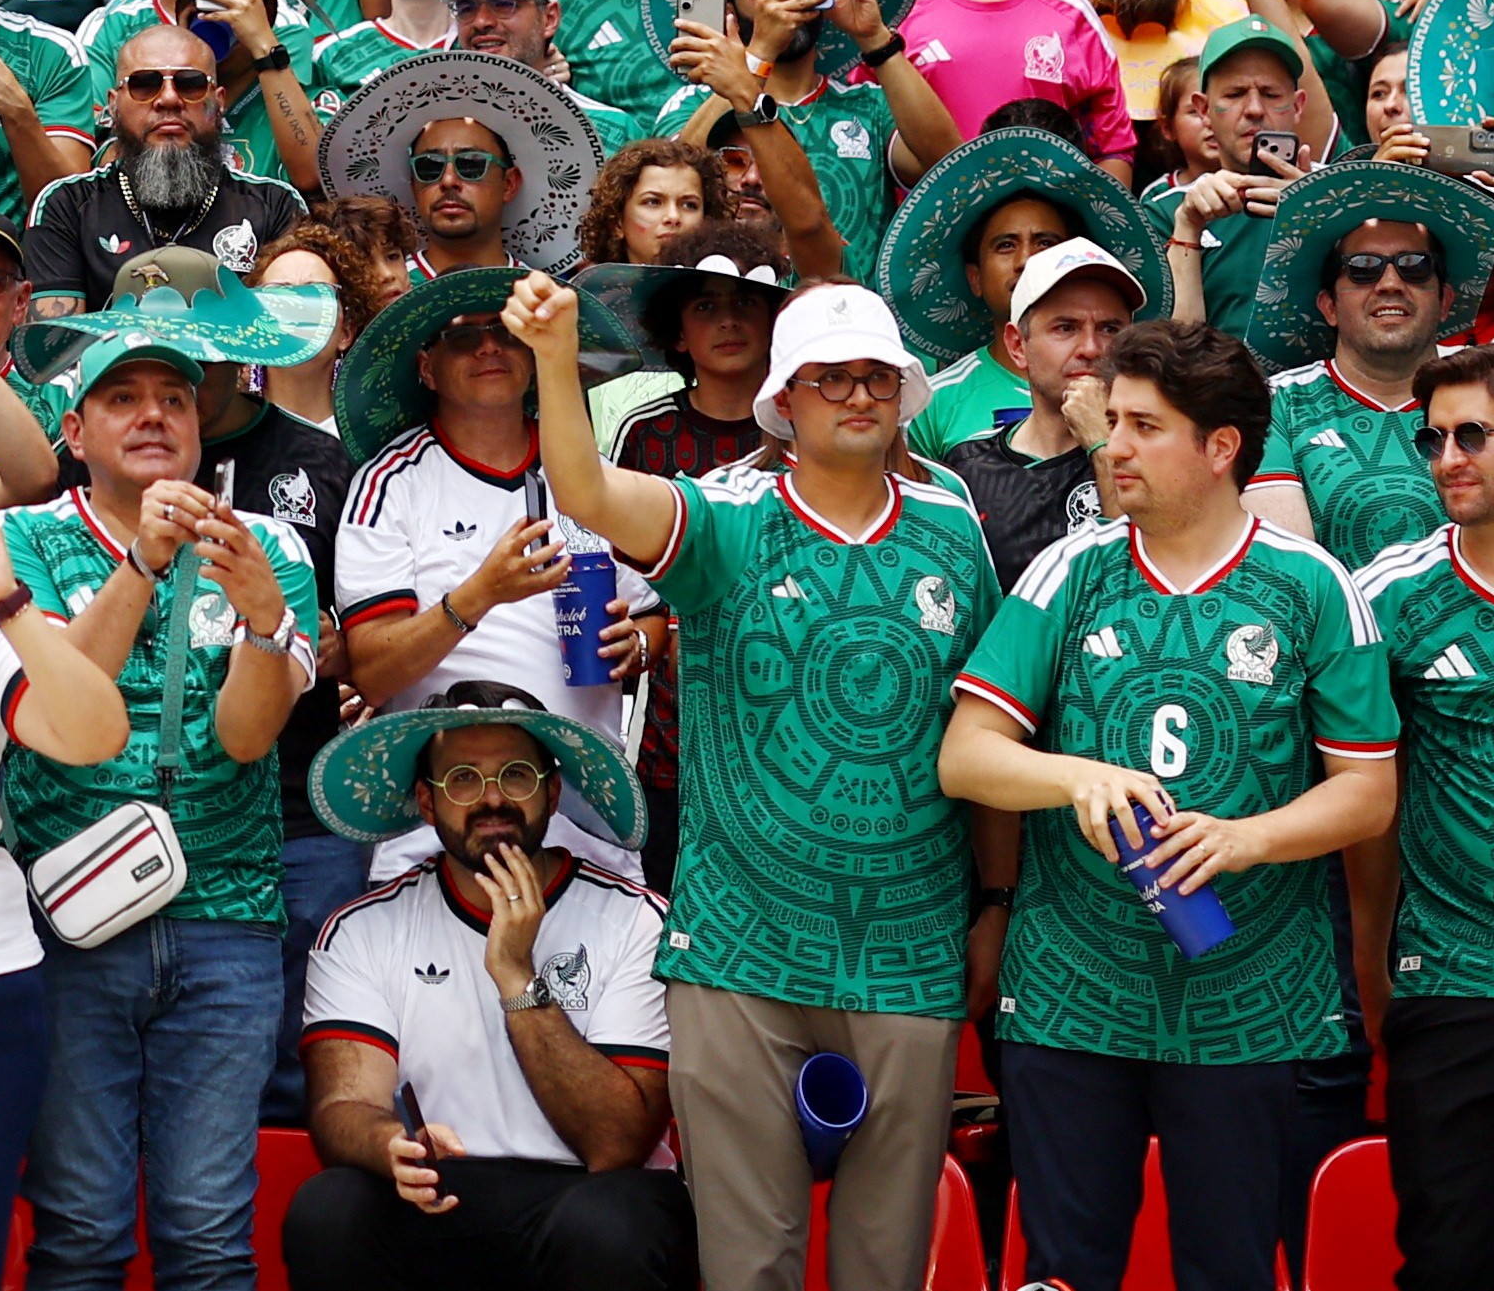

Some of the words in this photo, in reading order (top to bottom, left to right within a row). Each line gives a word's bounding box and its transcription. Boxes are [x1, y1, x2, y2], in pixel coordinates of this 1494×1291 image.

[445, 53, 472, 61] FIFA
[1409, 38, 1424, 67] FIFA
[374, 68, 398, 87] FIFA
[520, 68, 544, 87] FIFA
[574, 114, 592, 137] FIFA
[992, 131, 1020, 142] FIFA
[1068, 146, 1091, 169] FIFA
[1365, 163, 1392, 171] FIFA
[921, 164, 946, 189] FIFA
[1284, 177, 1310, 198] FIFA
[1129, 196, 1147, 222] FIFA
[884, 225, 901, 254] FIFA
[170, 553, 197, 646] EROMEXICO
[1150, 703, 1190, 777] 6
